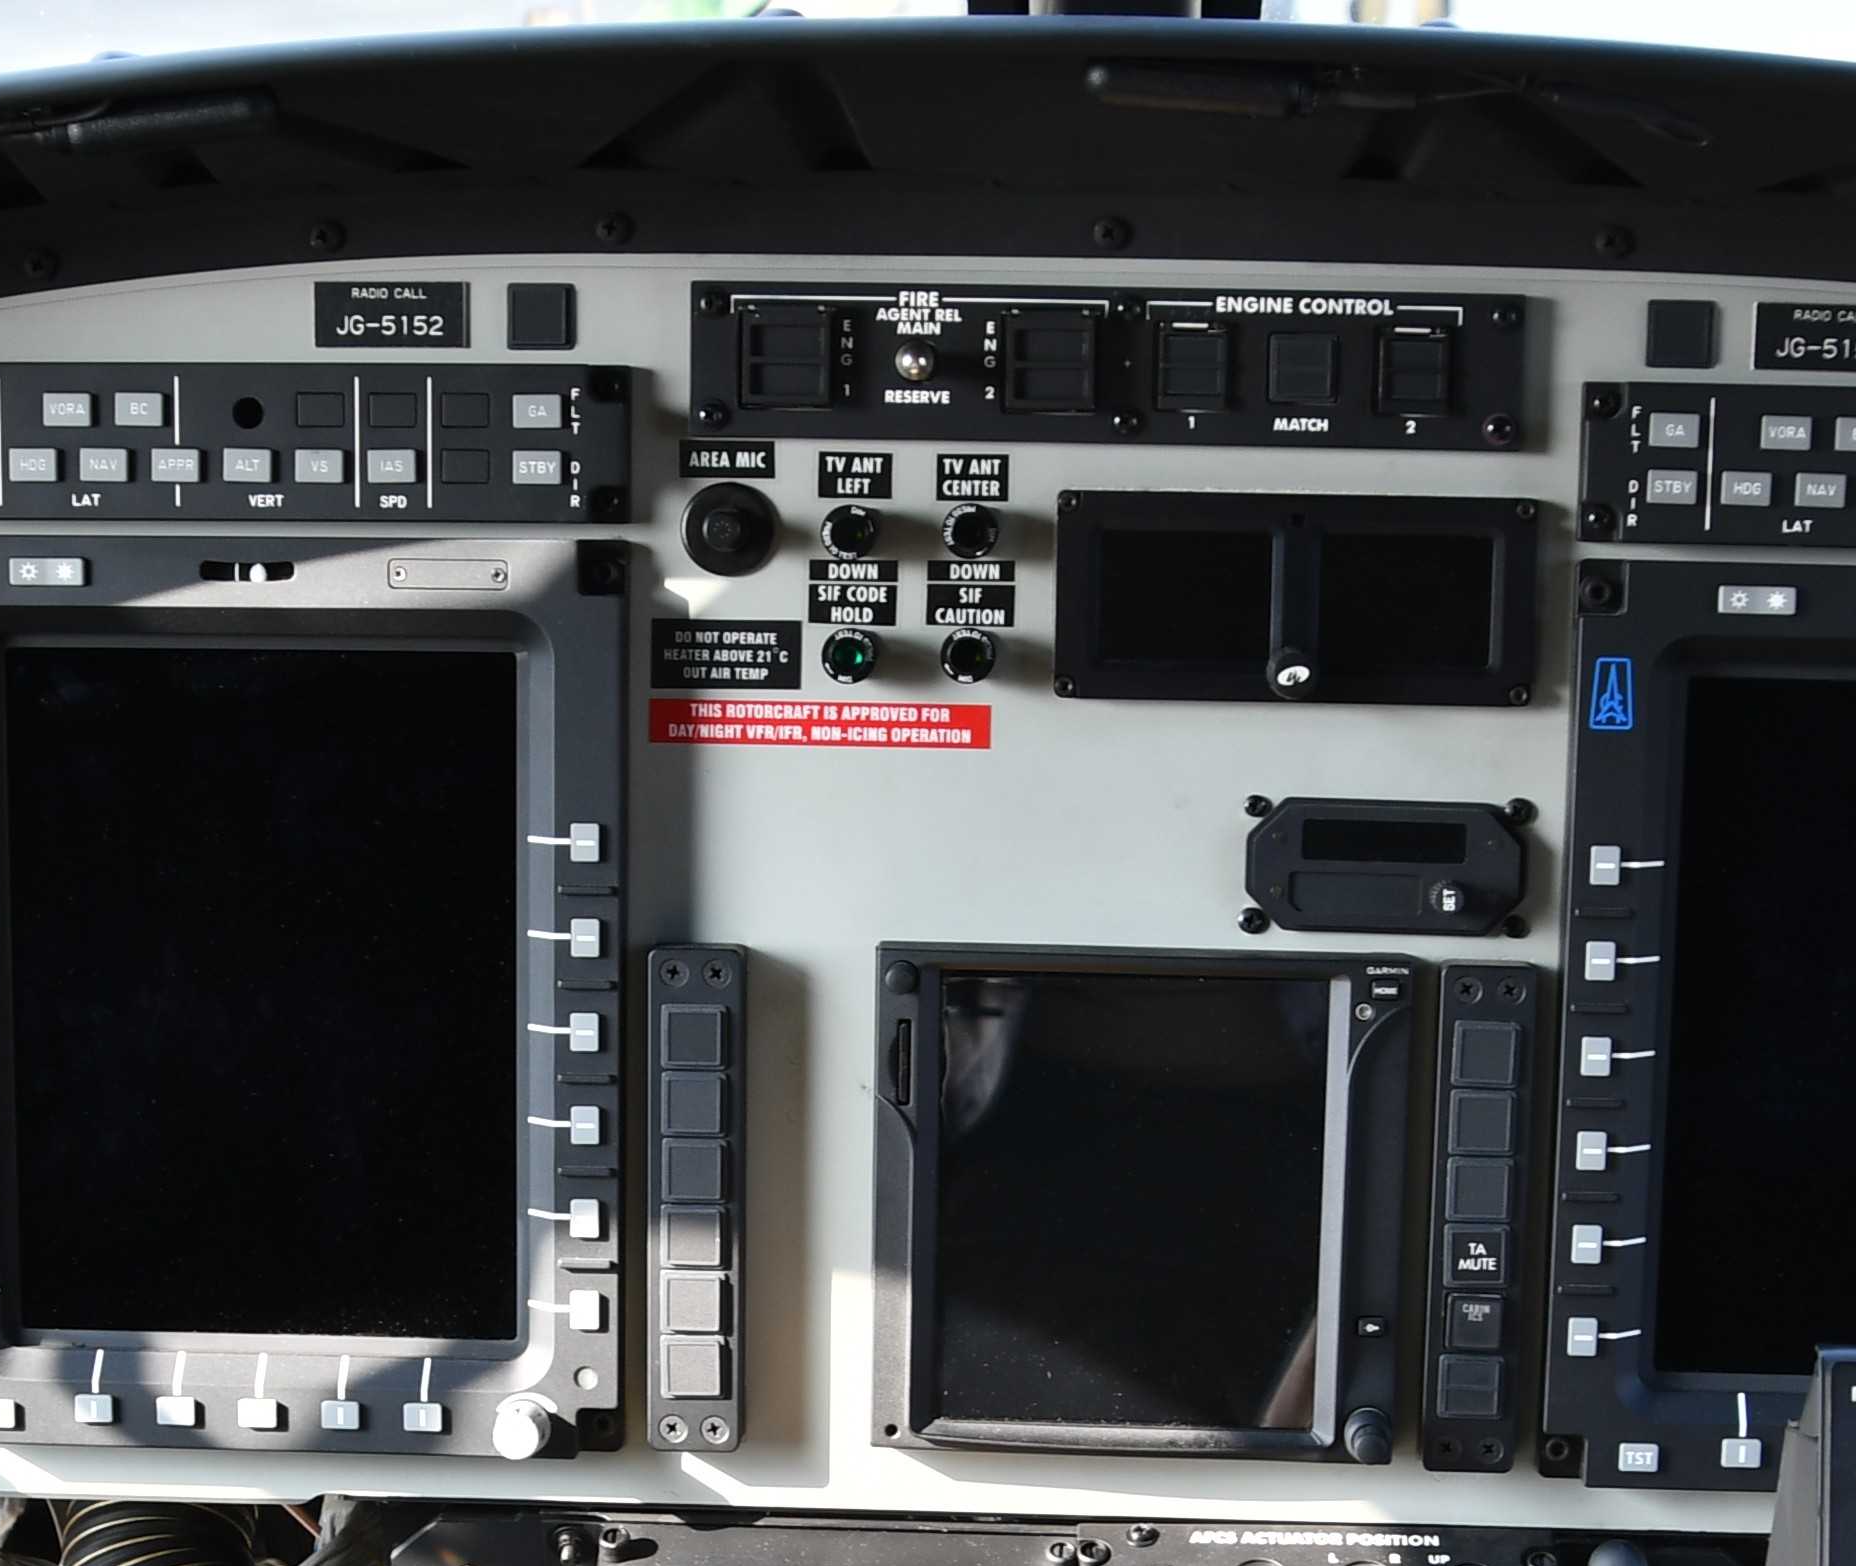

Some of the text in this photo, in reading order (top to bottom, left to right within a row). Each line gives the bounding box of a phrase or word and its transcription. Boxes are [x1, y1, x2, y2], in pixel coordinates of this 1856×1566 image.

[351, 287, 426, 299] RADIO CALL
[898, 292, 939, 307] FIRE
[1217, 297, 1393, 316] ENGINE CONTROL
[876, 308, 962, 322] AGENT REL
[1794, 308, 1833, 322] RADIO
[337, 316, 443, 336] JG-5152
[897, 322, 941, 335] MAIN
[885, 390, 950, 404] RESERVE
[528, 405, 547, 417] GA
[1274, 417, 1328, 433] MATCH
[90, 459, 117, 471] NAV
[158, 459, 194, 471] APPR
[235, 459, 262, 472] ALT
[381, 460, 403, 473] IAS
[689, 451, 766, 469] AREA MIC
[826, 456, 883, 475] TV ANT
[519, 462, 555, 474] STBY
[943, 459, 1000, 476] TV ANT
[837, 477, 871, 494] LEFT
[943, 479, 1000, 496] CENTER
[1654, 481, 1692, 493] STBY
[1733, 483, 1762, 495] HDG
[72, 494, 100, 507] LAT
[249, 495, 284, 507] VERT
[380, 495, 407, 509] SPD
[1782, 520, 1812, 534] LAT
[828, 564, 878, 579] DOWN
[950, 564, 1000, 579] DOWN
[818, 586, 887, 603] SIF CODE
[959, 587, 982, 603] SIF
[831, 607, 873, 623] HOLD
[935, 608, 1005, 624] CAUTION
[675, 631, 777, 645] DO NOT OPERATE
[664, 649, 710, 661] HEATER
[713, 650, 754, 663] ABOVE
[683, 668, 768, 680] OUT AIR TEMP
[690, 704, 950, 723] THIS ROTORCRAFT IS APPROVED FOR
[669, 723, 742, 739] DAY/NIGHT
[812, 726, 888, 742] NON-ICING
[892, 728, 971, 744] OPERATION
[1468, 1243, 1487, 1255] TA
[1458, 1258, 1497, 1270] MUTE
[1346, 1533, 1439, 1547] POSITION
[1428, 1554, 1450, 1565] UP
